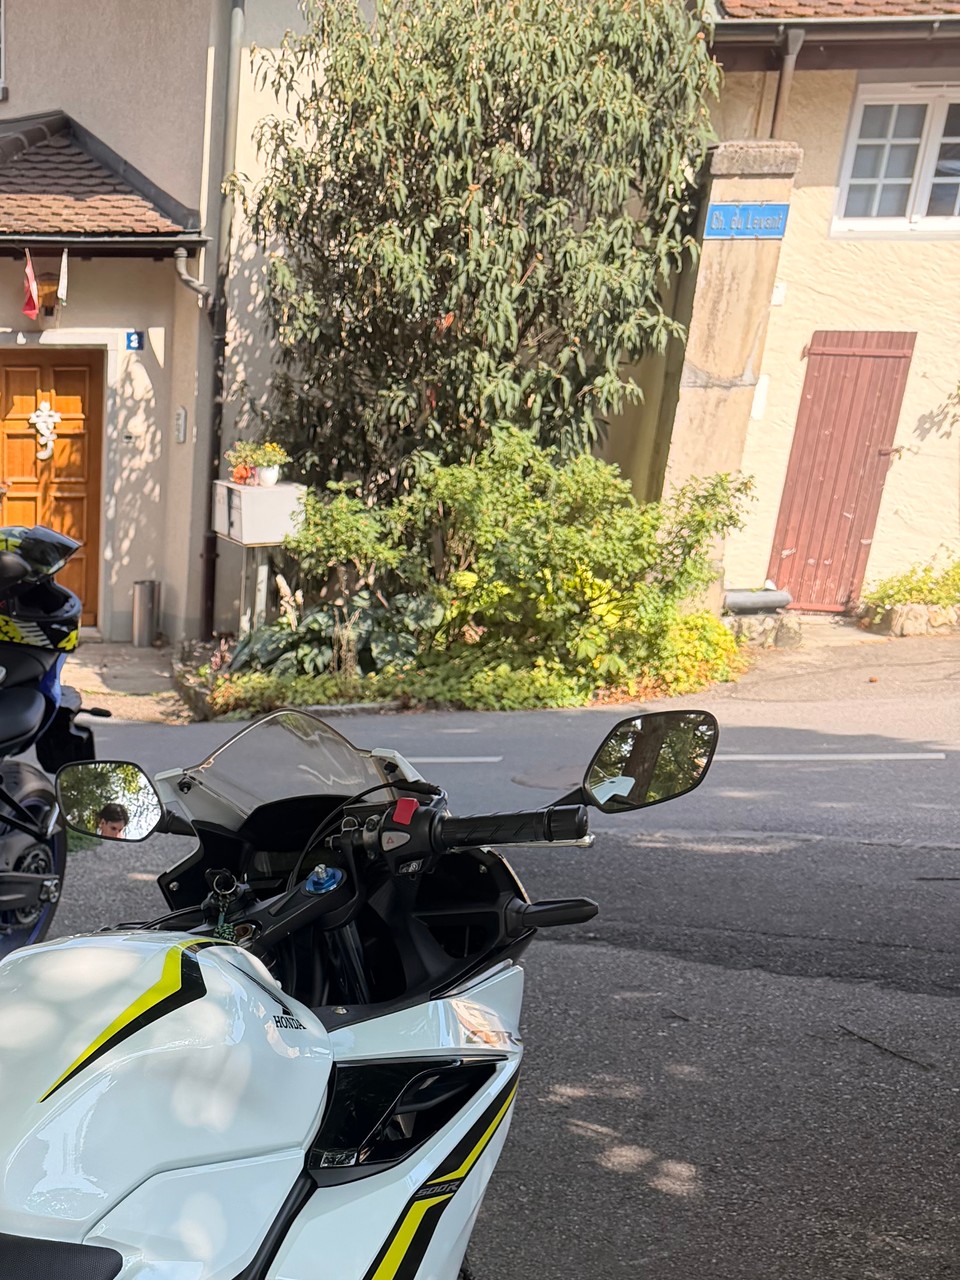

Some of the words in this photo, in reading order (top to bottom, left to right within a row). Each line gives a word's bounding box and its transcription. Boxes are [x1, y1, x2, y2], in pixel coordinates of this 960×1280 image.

[710, 210, 727, 231] Ch.
[730, 208, 743, 231] du
[745, 209, 783, 231] Levant
[272, 1015, 307, 1030] HONDA
[415, 1181, 461, 1198] 500R
